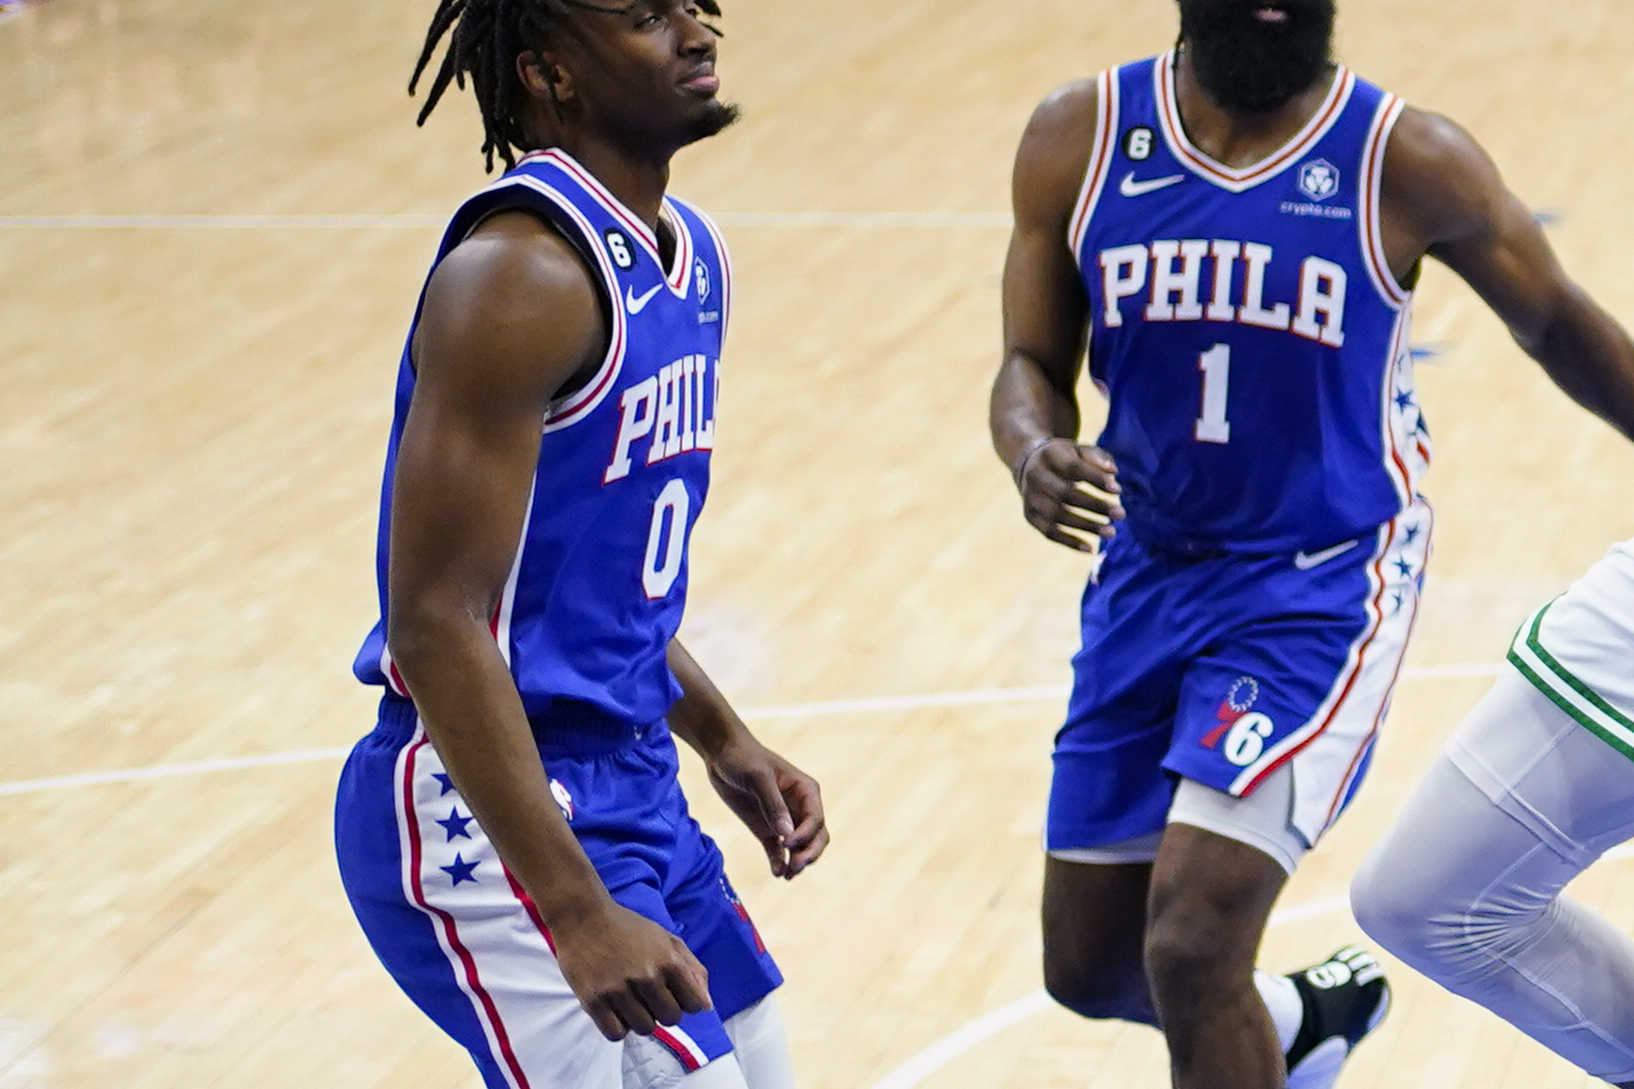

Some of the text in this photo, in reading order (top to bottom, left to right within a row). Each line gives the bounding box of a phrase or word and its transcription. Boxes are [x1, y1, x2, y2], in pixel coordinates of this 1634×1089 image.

[1128, 128, 1152, 160] 6
[606, 232, 632, 268] 6
[1280, 200, 1351, 218] crypto.com
[1099, 238, 1347, 348] PHILA
[603, 354, 721, 486] PHIL
[1194, 343, 1231, 444] 1
[642, 478, 690, 601] 0
[1200, 700, 1274, 767] 76
